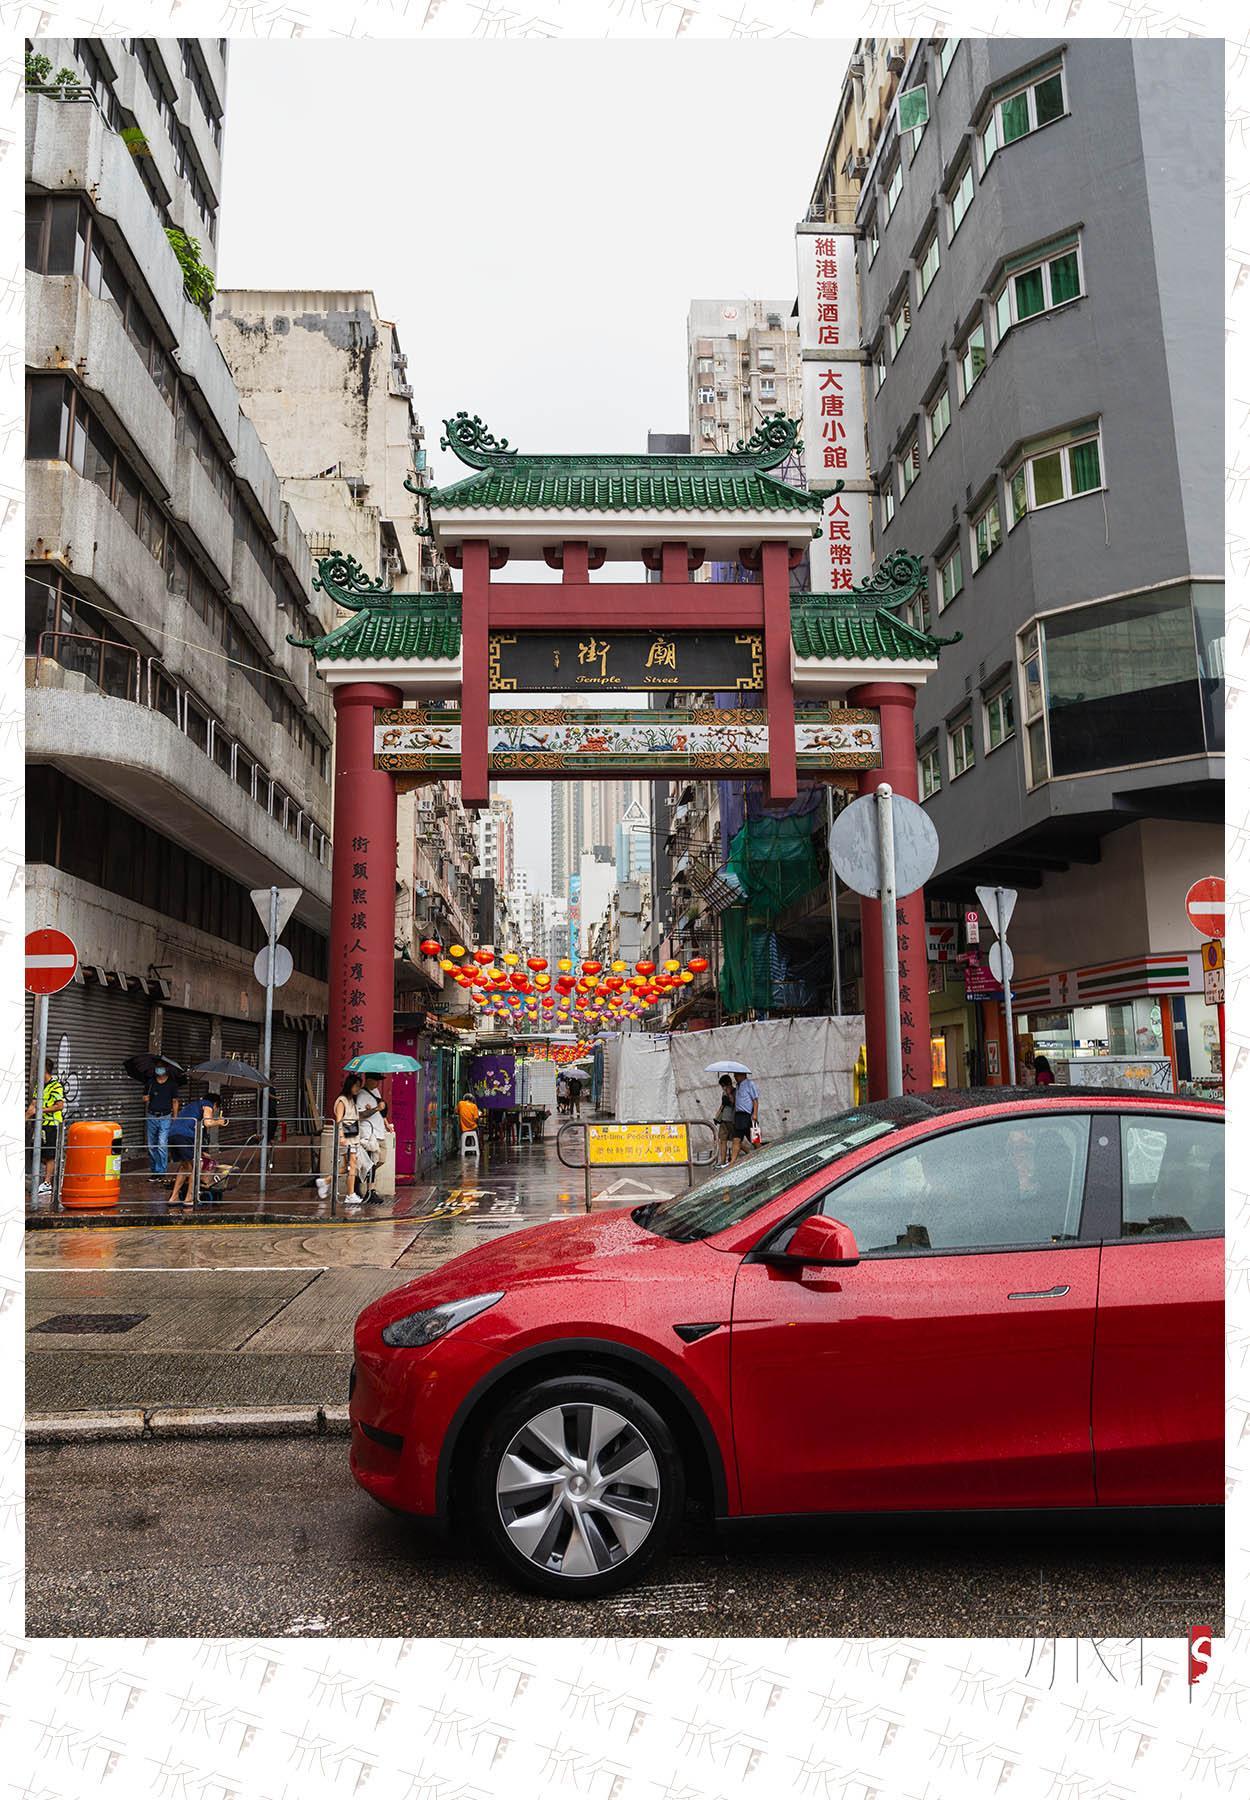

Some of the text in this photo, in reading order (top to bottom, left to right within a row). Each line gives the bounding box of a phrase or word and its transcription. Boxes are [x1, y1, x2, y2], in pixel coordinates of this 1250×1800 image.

[815, 237, 840, 346] 維港灣酒店
[818, 368, 848, 469] 大唐小館
[576, 676, 680, 685] Temple Street
